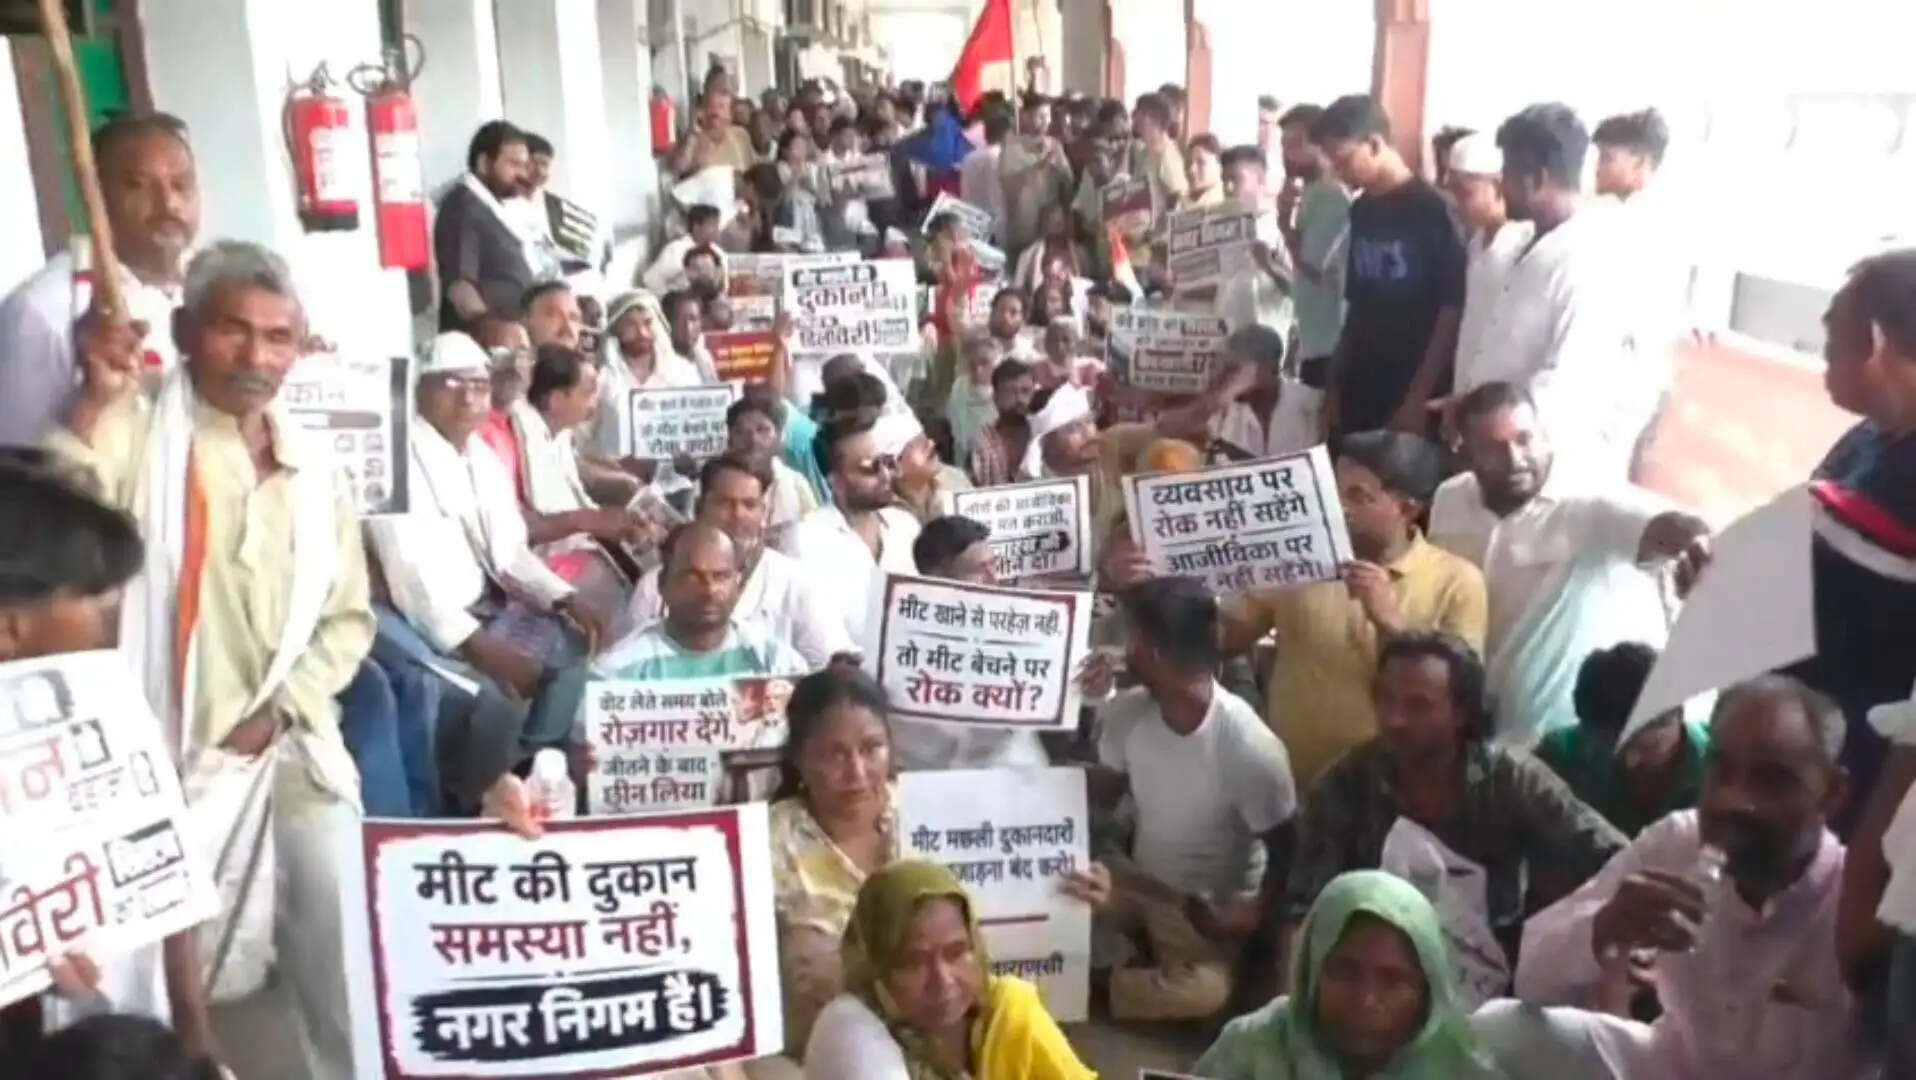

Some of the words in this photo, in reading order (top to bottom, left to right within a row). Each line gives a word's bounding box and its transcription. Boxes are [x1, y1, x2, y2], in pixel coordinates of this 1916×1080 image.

[1151, 475, 1254, 505] व्यवसाय
[1259, 467, 1295, 490] पर
[1152, 509, 1198, 539] रोक
[1203, 500, 1246, 531] नहीं
[1166, 538, 1280, 573] आजीविका
[1284, 533, 1313, 554] पर
[898, 593, 930, 621] मीट
[934, 601, 967, 628] खाने
[970, 602, 985, 629] से
[896, 639, 919, 669] तो
[925, 641, 963, 673] मीट
[970, 649, 1017, 677] बेचने
[1024, 658, 1053, 679] पर
[905, 669, 963, 706] रोक
[655, 752, 674, 775] के
[651, 776, 706, 803] लिया
[911, 824, 941, 853] मीट
[412, 849, 497, 906] मीट
[510, 850, 571, 905] की
[584, 856, 698, 913] दुकान
[430, 920, 586, 965] समस्या
[599, 902, 692, 956] नहीं,
[434, 1004, 532, 1050] नगर
[540, 986, 657, 1045] निगम
[662, 974, 713, 1035] है।
